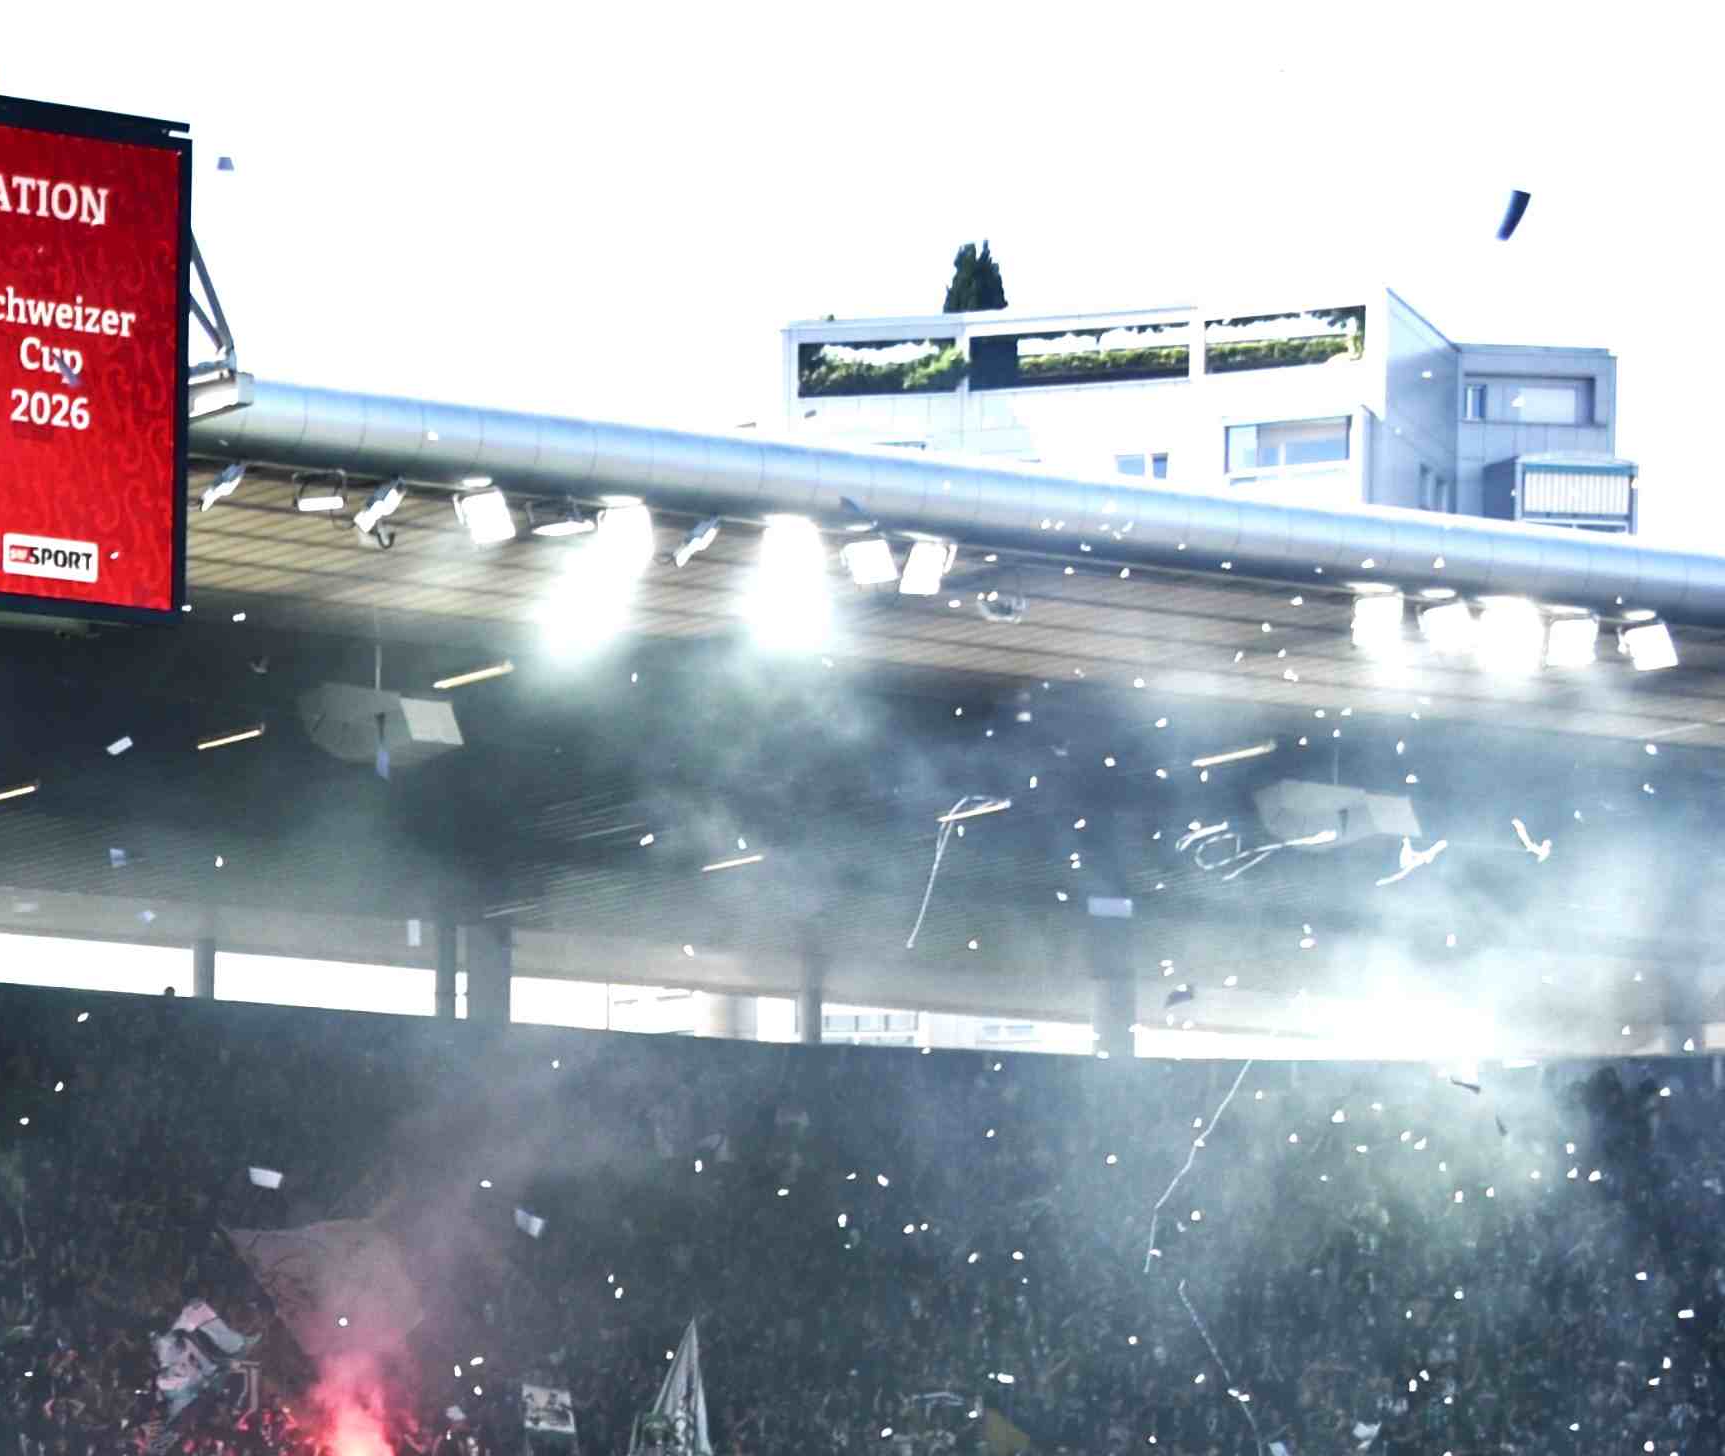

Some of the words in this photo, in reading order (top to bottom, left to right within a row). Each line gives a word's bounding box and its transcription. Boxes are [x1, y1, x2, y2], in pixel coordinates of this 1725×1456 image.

[19, 336, 85, 382] Cup
[10, 390, 90, 431] 2026
[29, 546, 94, 572] SPORT
